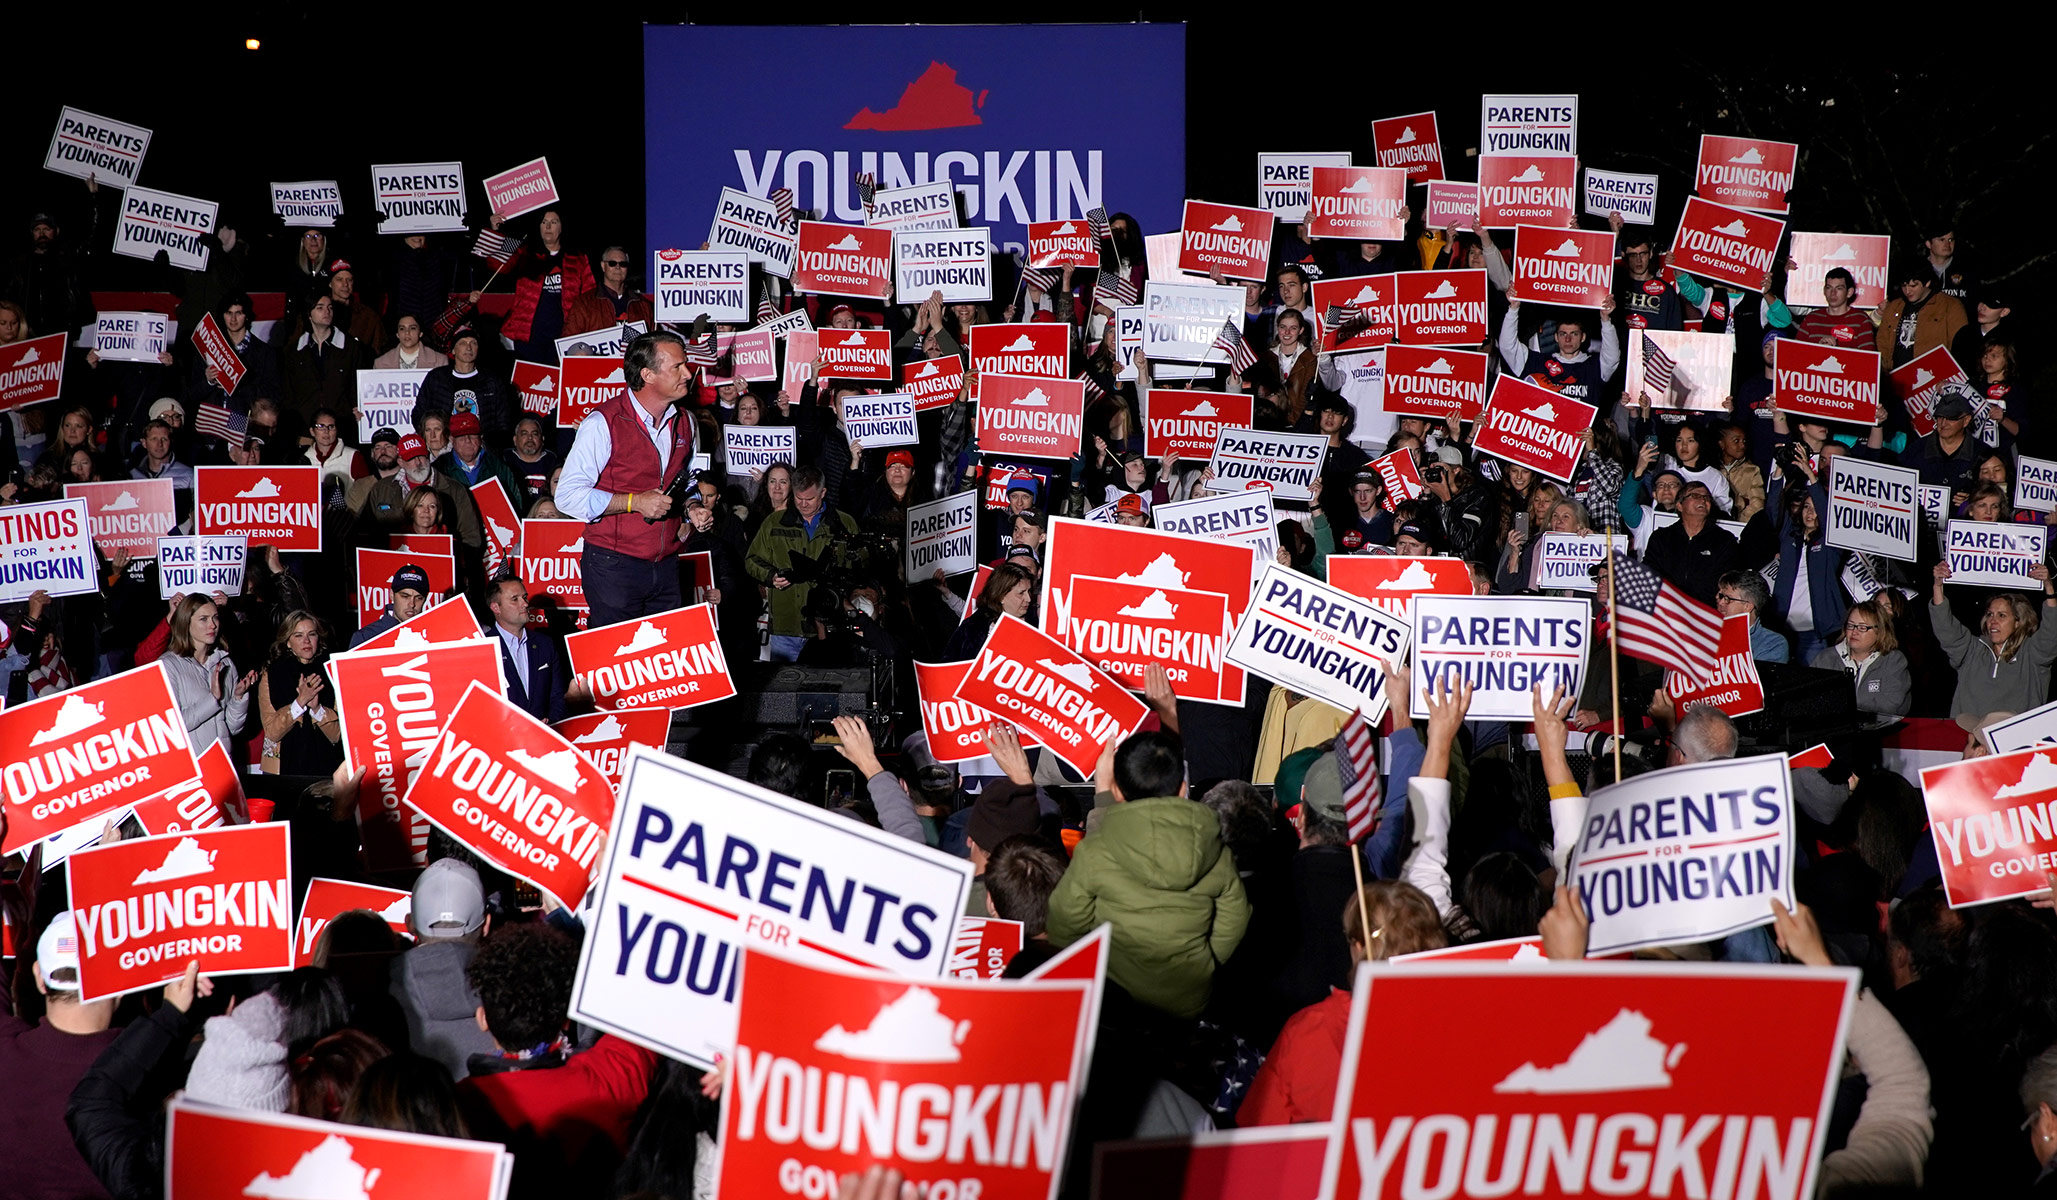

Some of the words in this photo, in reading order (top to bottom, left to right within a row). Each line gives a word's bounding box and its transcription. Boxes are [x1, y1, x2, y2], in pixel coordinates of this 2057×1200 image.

[1488, 107, 1572, 122] PARENTS
[61, 118, 144, 153] PARENTS
[1488, 133, 1570, 152] YOUNGKIN
[56, 141, 135, 179] YOUNGKIN
[1380, 143, 1439, 167] YOUNGKIN
[1264, 165, 1309, 180] PARE
[1407, 165, 1428, 173] ERNOR
[1701, 164, 1790, 192] YOUNGKIN
[275, 187, 337, 201] PARENTS
[379, 174, 458, 191] PARENTS
[493, 176, 550, 208] YOUNGKIN
[734, 149, 1103, 224] YOUNGKIN
[1588, 177, 1654, 195] PARENTS
[1716, 187, 1768, 199] GOVERNOR
[382, 200, 461, 218] YOUNGKIN
[1264, 191, 1310, 209] YOUN
[1314, 196, 1402, 218] YOUNGKIN
[1482, 186, 1572, 209] YOUNGKIN
[1589, 194, 1651, 216] YOUNGKIN
[126, 198, 210, 228] PARENTS
[277, 203, 339, 217] YOUNGKIN
[1499, 208, 1552, 217] GOVERNOR
[751, 226, 762, 234] FOR
[1330, 219, 1382, 227] GOVERNOR
[123, 222, 203, 257] YOUNGKIN
[717, 225, 791, 265] YOUNGKIN
[901, 241, 985, 258] PARENTS
[1184, 230, 1268, 261] YOUNGKIN
[1682, 227, 1773, 273] YOUNGKIN
[661, 263, 743, 278] PARENTS
[800, 251, 888, 279] YOUNGKIN
[1198, 254, 1247, 267] GOVERNOR
[1693, 254, 1747, 274] GOVERNOR
[816, 274, 868, 285] GOVERNOR
[903, 268, 985, 289] YOUNGKIN
[1518, 257, 1610, 288] YOUNGKIN
[661, 289, 743, 309] YOUNGKIN
[1533, 281, 1588, 294] GOVERNOR
[1399, 302, 1485, 326] YOUNGKIN
[1416, 326, 1467, 334] GOVERNOR
[197, 320, 238, 384] YOUNGKIN
[211, 330, 234, 364] GOVERNOR
[820, 347, 889, 366] YOUNGKIN
[0, 360, 62, 389] OUNGKIN
[834, 365, 875, 373] GOVERNOR
[975, 355, 1064, 377] YOUNGKIN
[1351, 368, 1383, 378] YOUNGKI
[3, 384, 43, 399] GOVERNOR
[364, 383, 420, 398] PAREN
[565, 387, 624, 406] YOUN
[1386, 374, 1483, 404] YOUNGKIN
[1778, 369, 1875, 404] YOUNGKIN
[846, 402, 911, 418] PARENTS
[914, 392, 954, 406] GOVERNOR
[1405, 397, 1462, 409] GOVERNOR
[1796, 394, 1854, 410] GOVERNOR
[365, 410, 412, 428] YOUN
[847, 420, 913, 440] YOUNGKIN
[981, 406, 1080, 438] YOUNGKIN
[403, 439, 421, 450] USA
[728, 433, 792, 447] PARENTS
[999, 432, 1058, 445] GOVERNOR
[1169, 440, 1215, 449] GOVERN
[1488, 408, 1581, 459] YOUNGKIN
[729, 451, 791, 466] YOUNGKIN
[1221, 438, 1319, 459] PARENTS
[1501, 435, 1553, 460] GOVERNOR
[1217, 461, 1313, 487] YOUNGKIN
[1835, 472, 1912, 504] PARENTS
[201, 502, 317, 528] YOUNGKIN
[1866, 500, 1878, 508] FOR
[1928, 489, 1941, 530] PARE
[0, 509, 78, 544] TINOS
[911, 506, 972, 538] PARENTS
[1162, 505, 1268, 535] PARENTS
[1834, 505, 1910, 544] YOUNGKIN
[225, 528, 293, 538] GOVERNOR
[936, 531, 946, 539] FOR
[1951, 530, 2041, 551] PARENTS
[14, 547, 37, 557] FOR
[162, 545, 242, 562] PARENTS
[911, 535, 971, 570] YOUNGKIN
[0, 556, 84, 585] UNGKIN
[525, 558, 582, 583] YOUN
[1951, 554, 2038, 577] YOUNGKIN
[164, 568, 240, 588] YOUNGKIN
[1266, 579, 1401, 654] PARENTS
[1314, 629, 1335, 644] FOR
[1421, 615, 1582, 647] PARENTS
[1070, 617, 1221, 673] YOUNGKIN
[1490, 651, 1512, 659] FOR
[578, 641, 726, 697] YOUNGKIN
[1099, 659, 1188, 682] GOVEOR
[1249, 619, 1385, 700] YOUNGKIN
[1421, 659, 1578, 697] YOUNGKIN
[616, 680, 699, 710] GOVERNOR
[977, 648, 1130, 748] YOUNGKIN
[995, 693, 1082, 747] GOVERNOR
[0, 708, 187, 805] OUNGKIN
[367, 702, 401, 822] GOVERNOR
[31, 766, 151, 820] GOVERNOR
[1583, 786, 1780, 852] PARENTS
[452, 797, 560, 872] GOVERNOR
[1936, 800, 2057, 867] YOUN
[1654, 844, 1681, 856] FOR
[1990, 854, 2057, 879] GOVE
[630, 805, 938, 960] PARENTS
[1580, 844, 1780, 923] YOUNGKIN
[75, 879, 288, 959] YOUNGKIN
[746, 914, 790, 947] FOR
[119, 935, 241, 969] GOVERNOR
[736, 1045, 1066, 1172] YOUNGKIN
[1353, 1113, 1812, 1200] YOUNGKIN
[779, 1159, 983, 1200] GOVOR
